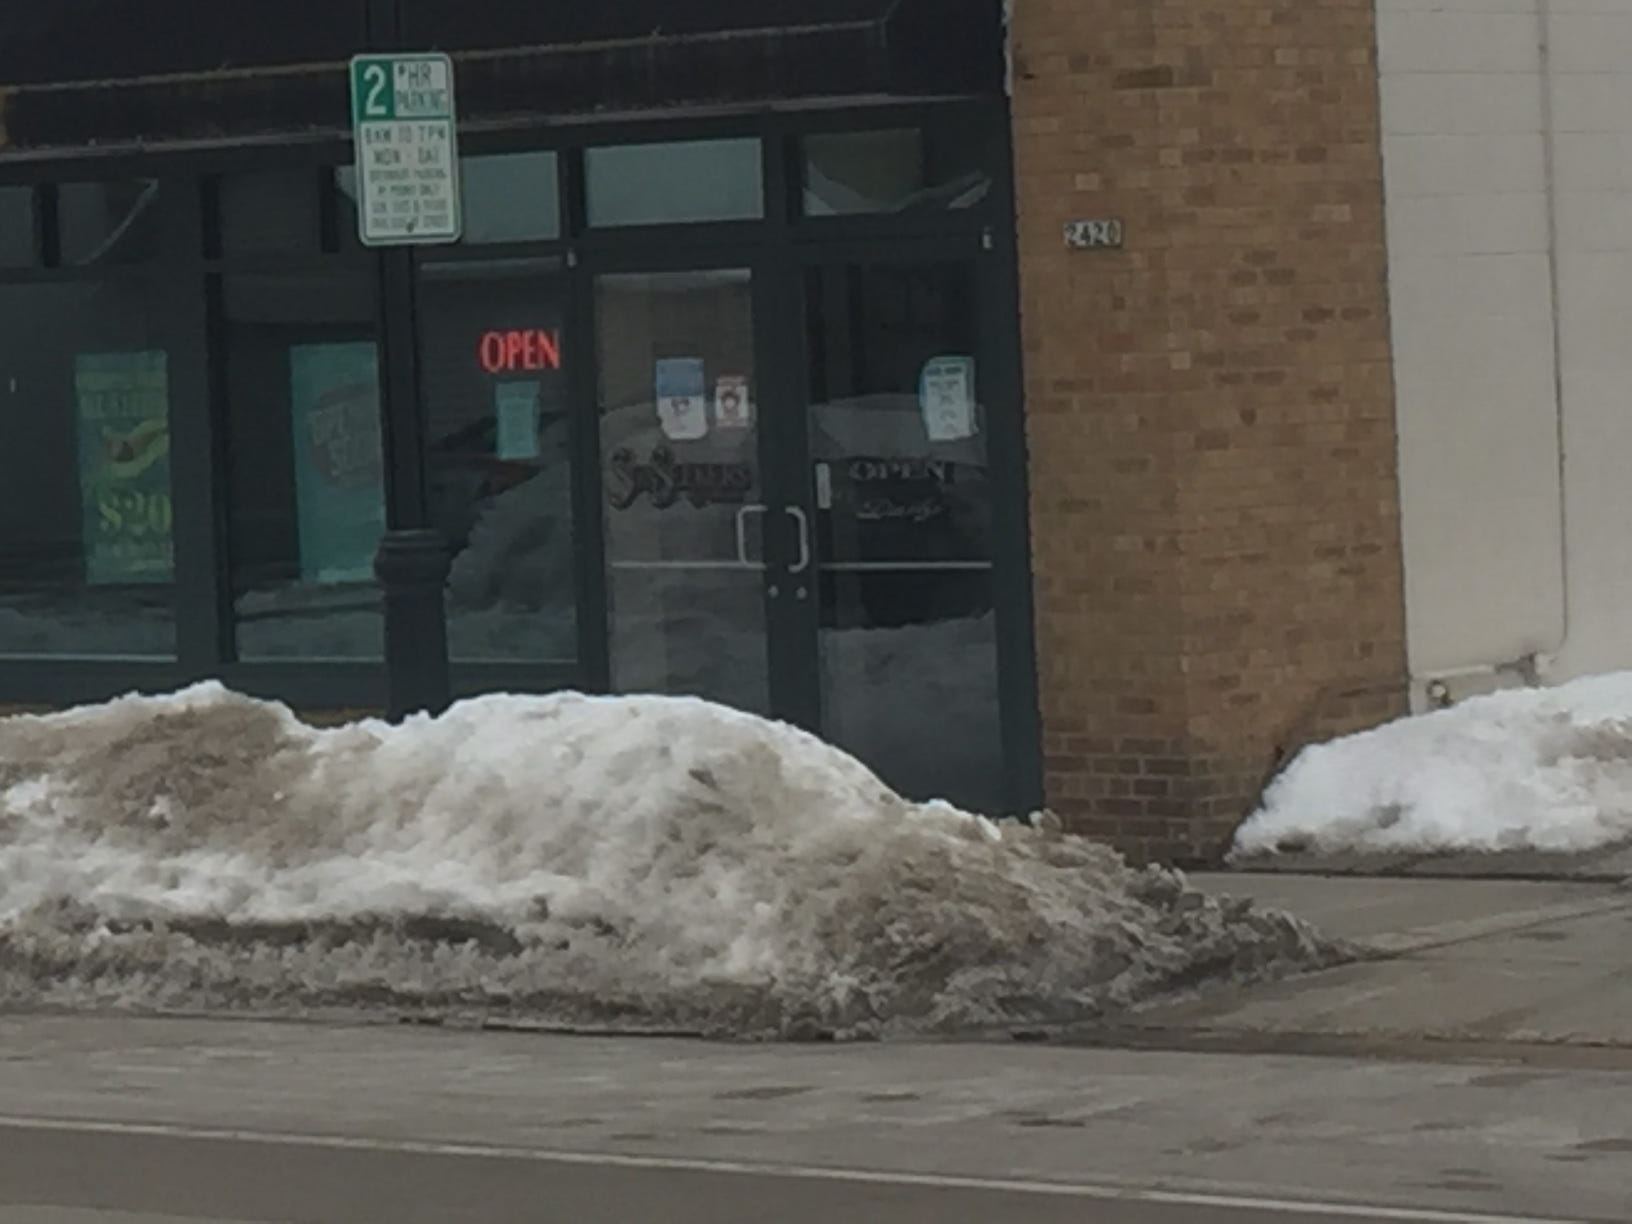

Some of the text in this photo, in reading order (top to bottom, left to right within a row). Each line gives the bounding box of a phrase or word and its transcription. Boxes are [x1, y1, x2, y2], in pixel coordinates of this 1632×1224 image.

[363, 64, 387, 115] 2
[408, 63, 432, 87] HR
[479, 329, 561, 373] OPEN
[848, 459, 946, 482] OPEN
